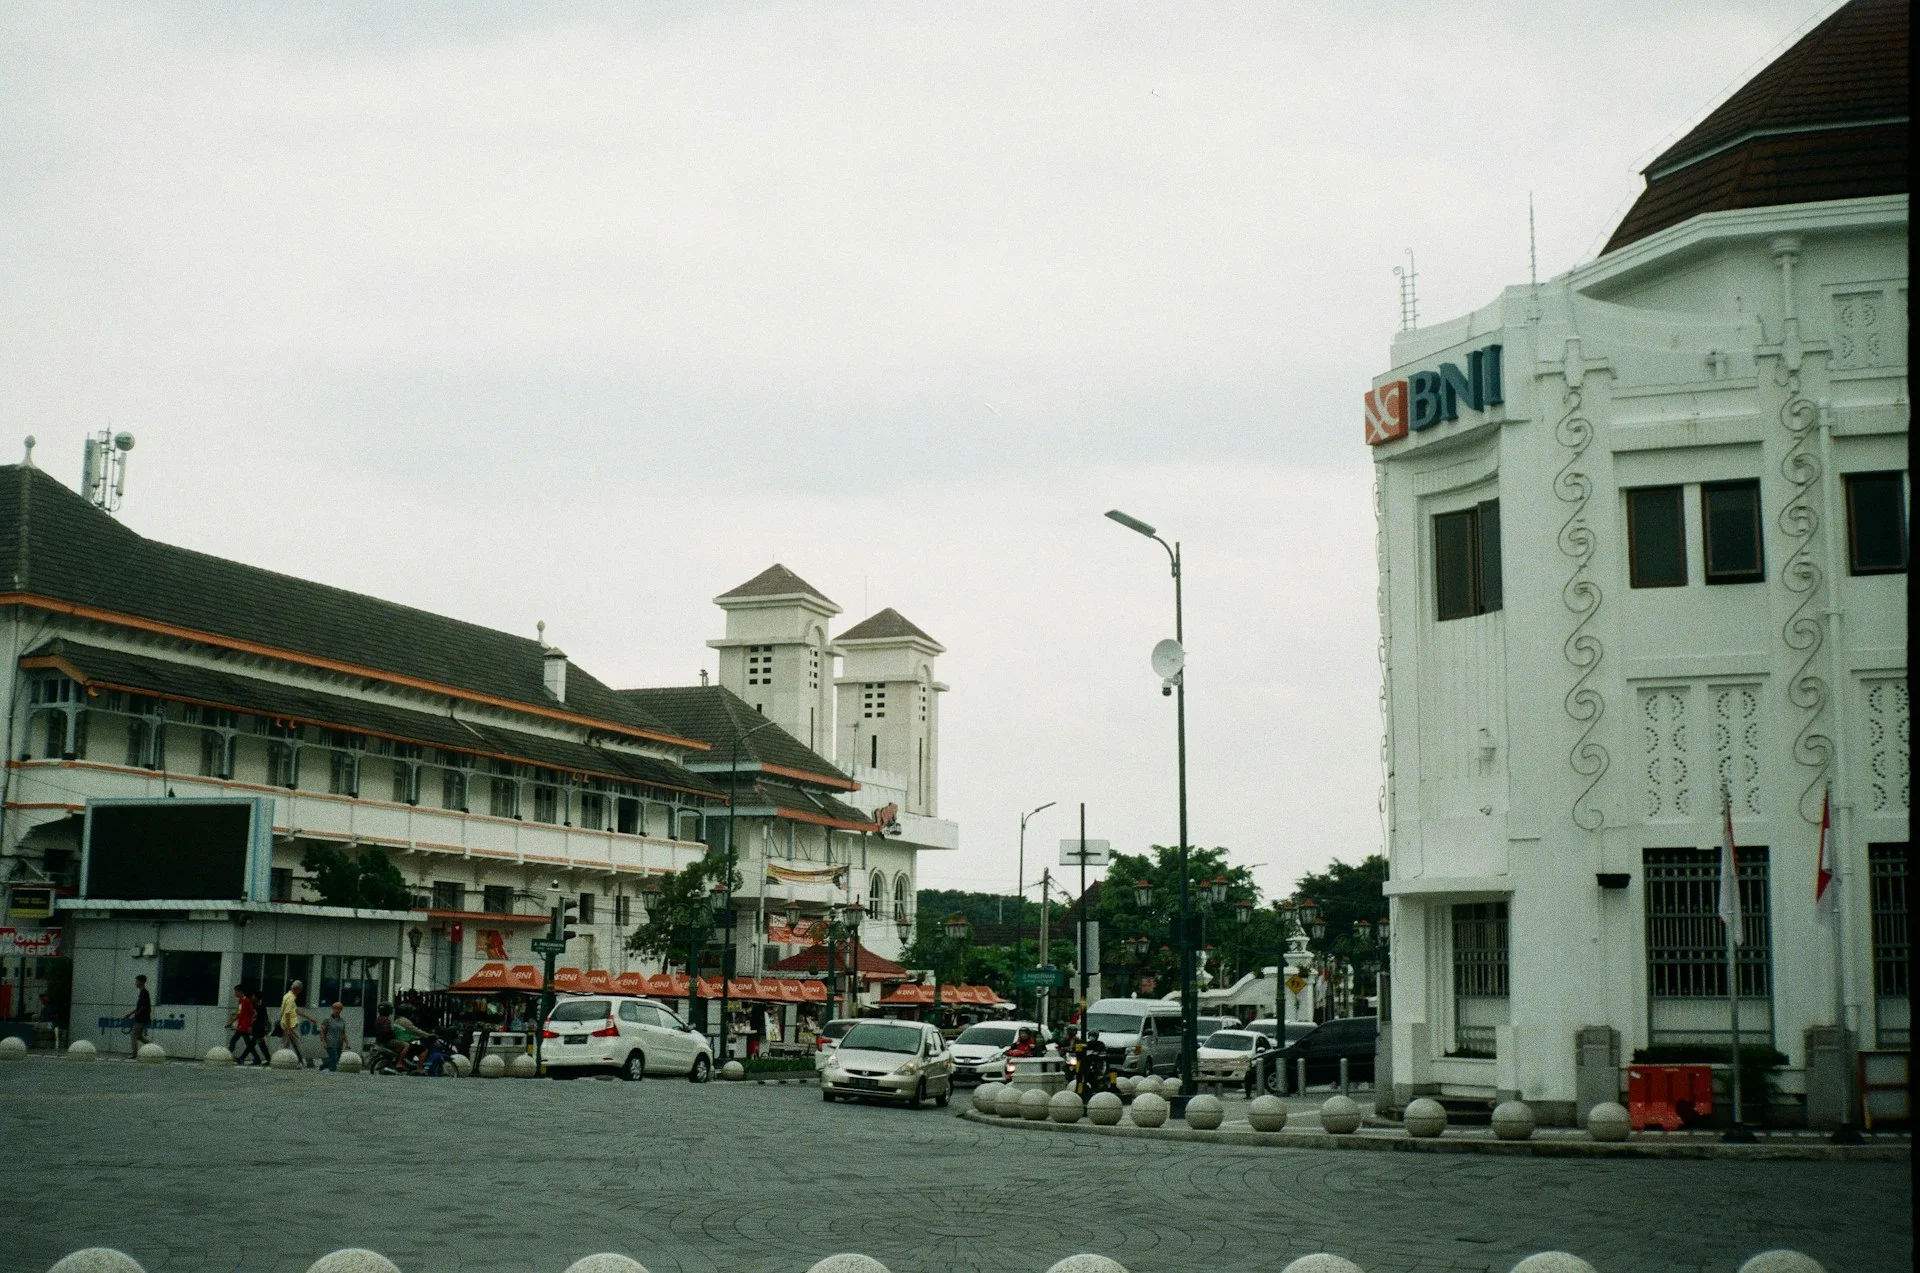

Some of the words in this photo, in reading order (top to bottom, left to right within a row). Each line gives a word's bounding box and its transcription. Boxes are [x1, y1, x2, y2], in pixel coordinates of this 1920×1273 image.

[1408, 344, 1504, 432] BNI
[3, 932, 57, 943] MONEY
[0, 944, 56, 955] ANGER
[516, 971, 532, 979] BNI
[560, 973, 577, 981] BNI
